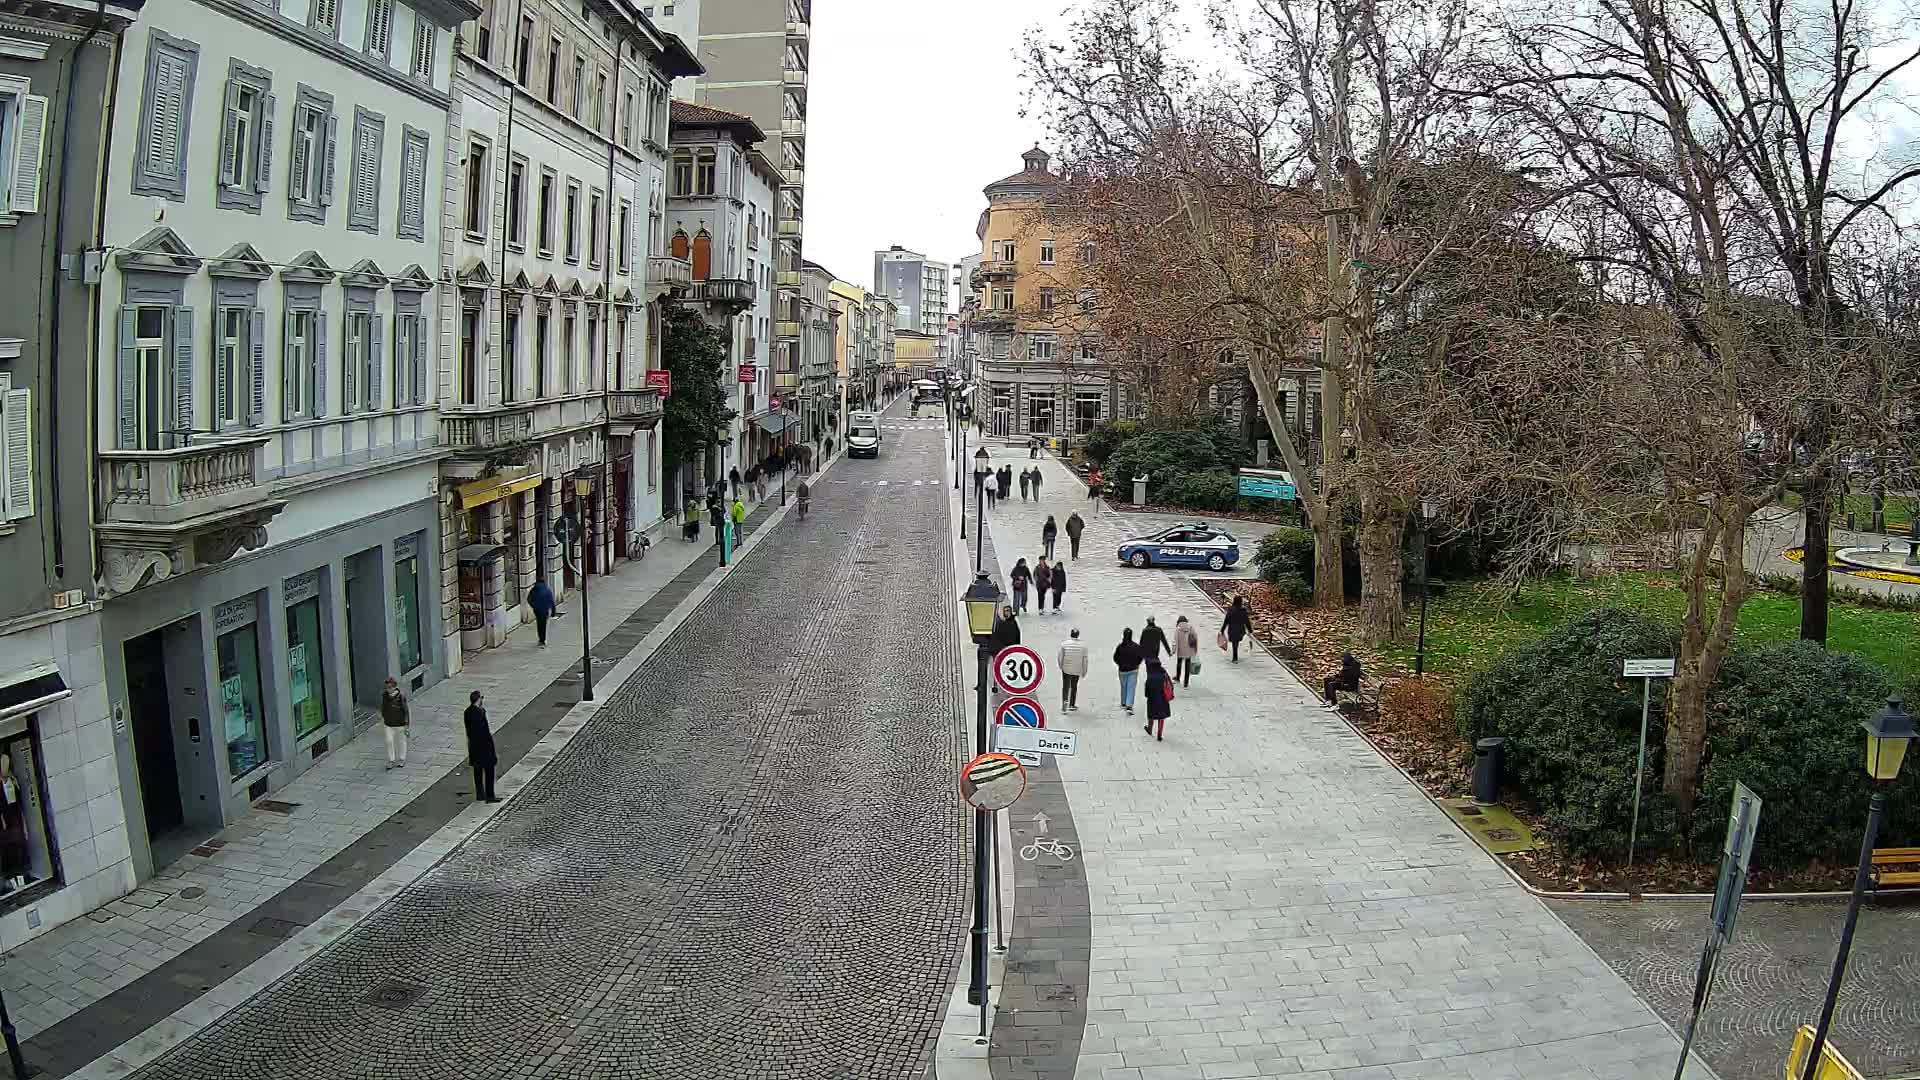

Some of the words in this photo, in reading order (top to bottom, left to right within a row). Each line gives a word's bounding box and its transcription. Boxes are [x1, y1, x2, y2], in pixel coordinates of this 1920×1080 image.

[1159, 548, 1206, 556] POLIZIA
[1006, 658, 1033, 681] 30
[1038, 739, 1070, 750] Dante
